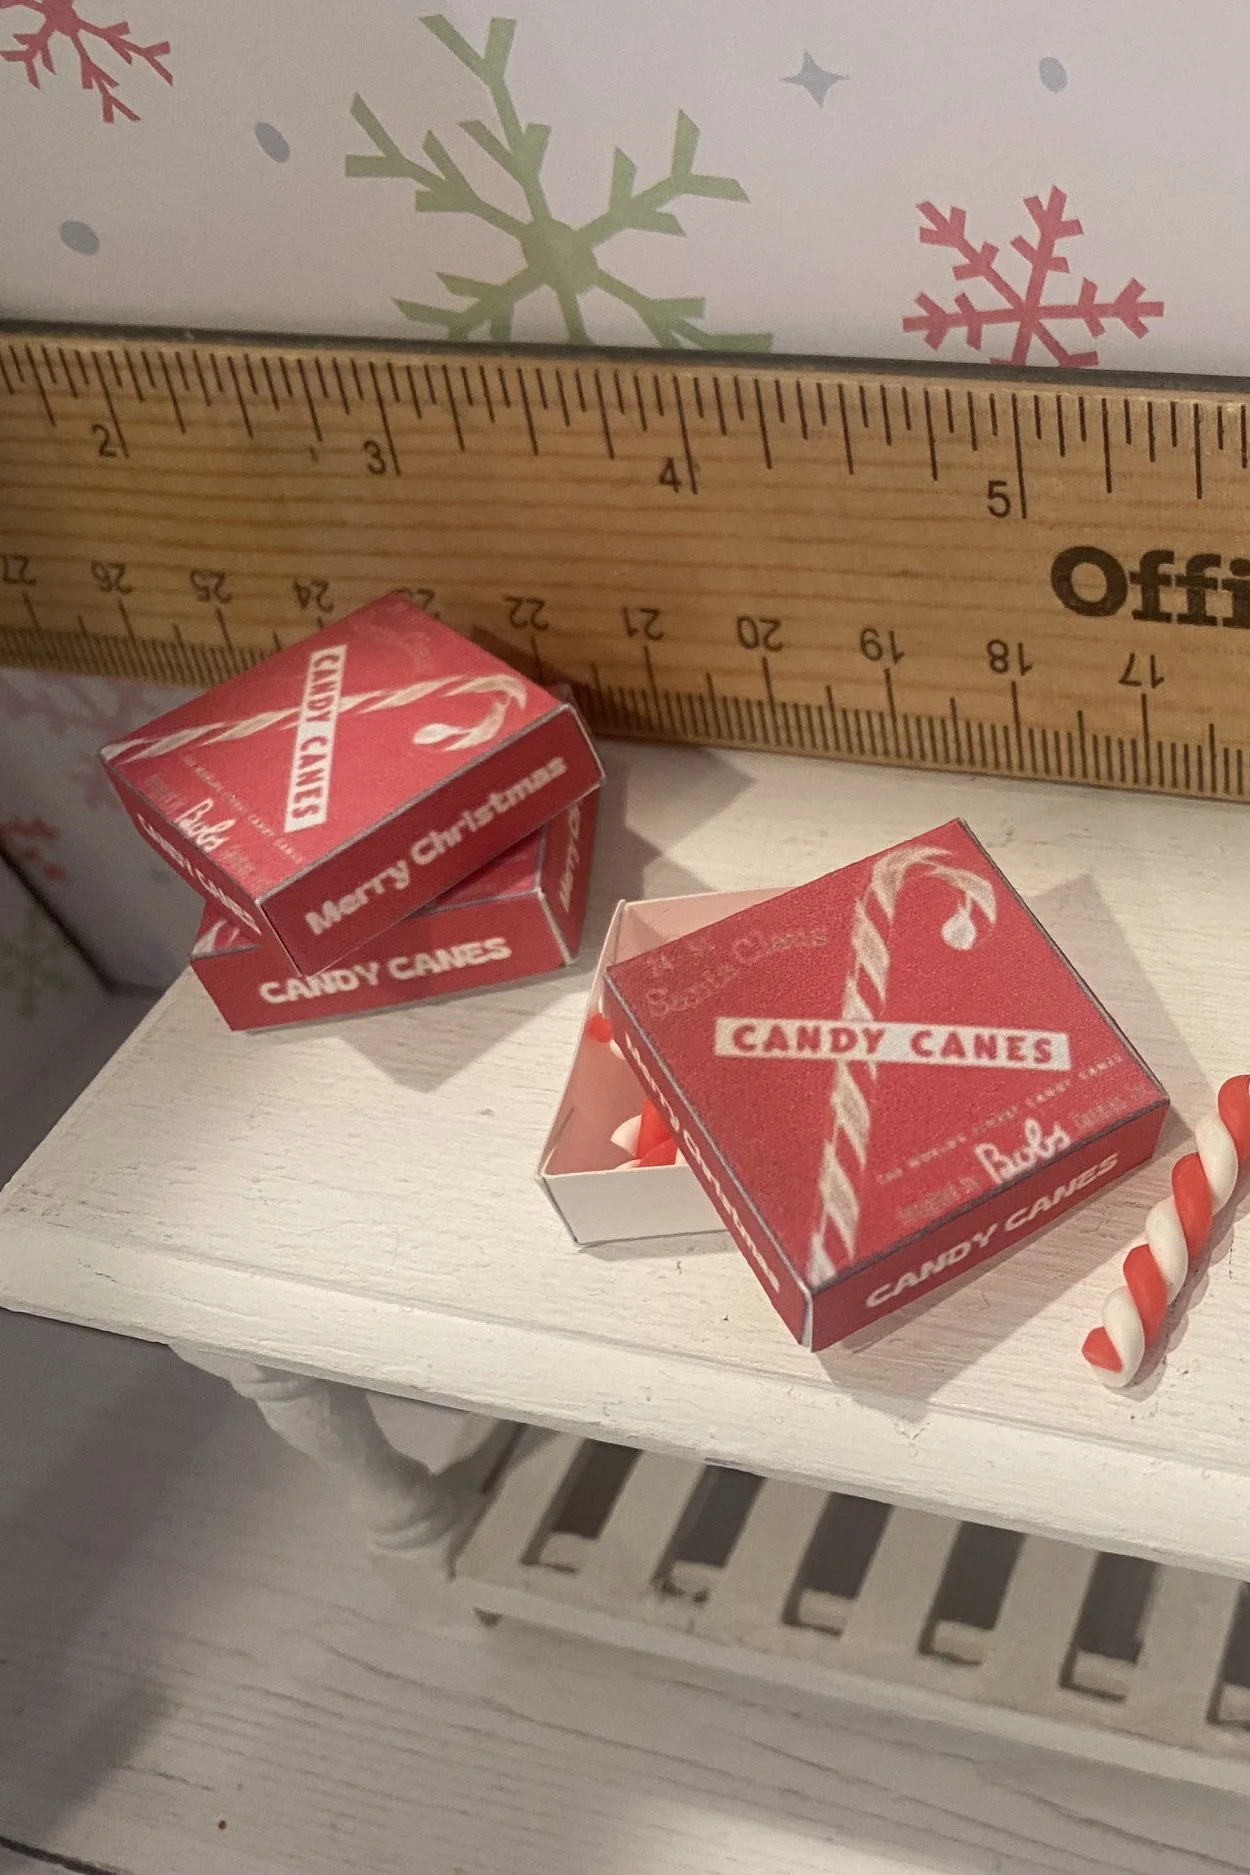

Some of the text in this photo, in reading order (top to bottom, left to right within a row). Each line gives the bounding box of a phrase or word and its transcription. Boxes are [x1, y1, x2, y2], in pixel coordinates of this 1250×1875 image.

[92, 425, 117, 457] 2
[363, 441, 386, 475] 3
[659, 458, 682, 492] 4
[987, 481, 1011, 518] 5
[91, 563, 133, 594] 26
[191, 569, 232, 602] 25
[506, 595, 549, 631] 22
[621, 607, 665, 640] 21
[737, 615, 783, 651] 20
[860, 628, 904, 663] 19
[987, 640, 1033, 675] 18
[1118, 653, 1164, 689] 17
[291, 654, 340, 819] CANDY CANES
[304, 859, 411, 936] Merry
[410, 755, 568, 866] Christmas
[259, 937, 512, 1004] CANDY CANES
[731, 1024, 1052, 1064] CANDY CANES
[865, 1223, 999, 1308] CANDY
[1004, 1153, 1119, 1232] CANES
